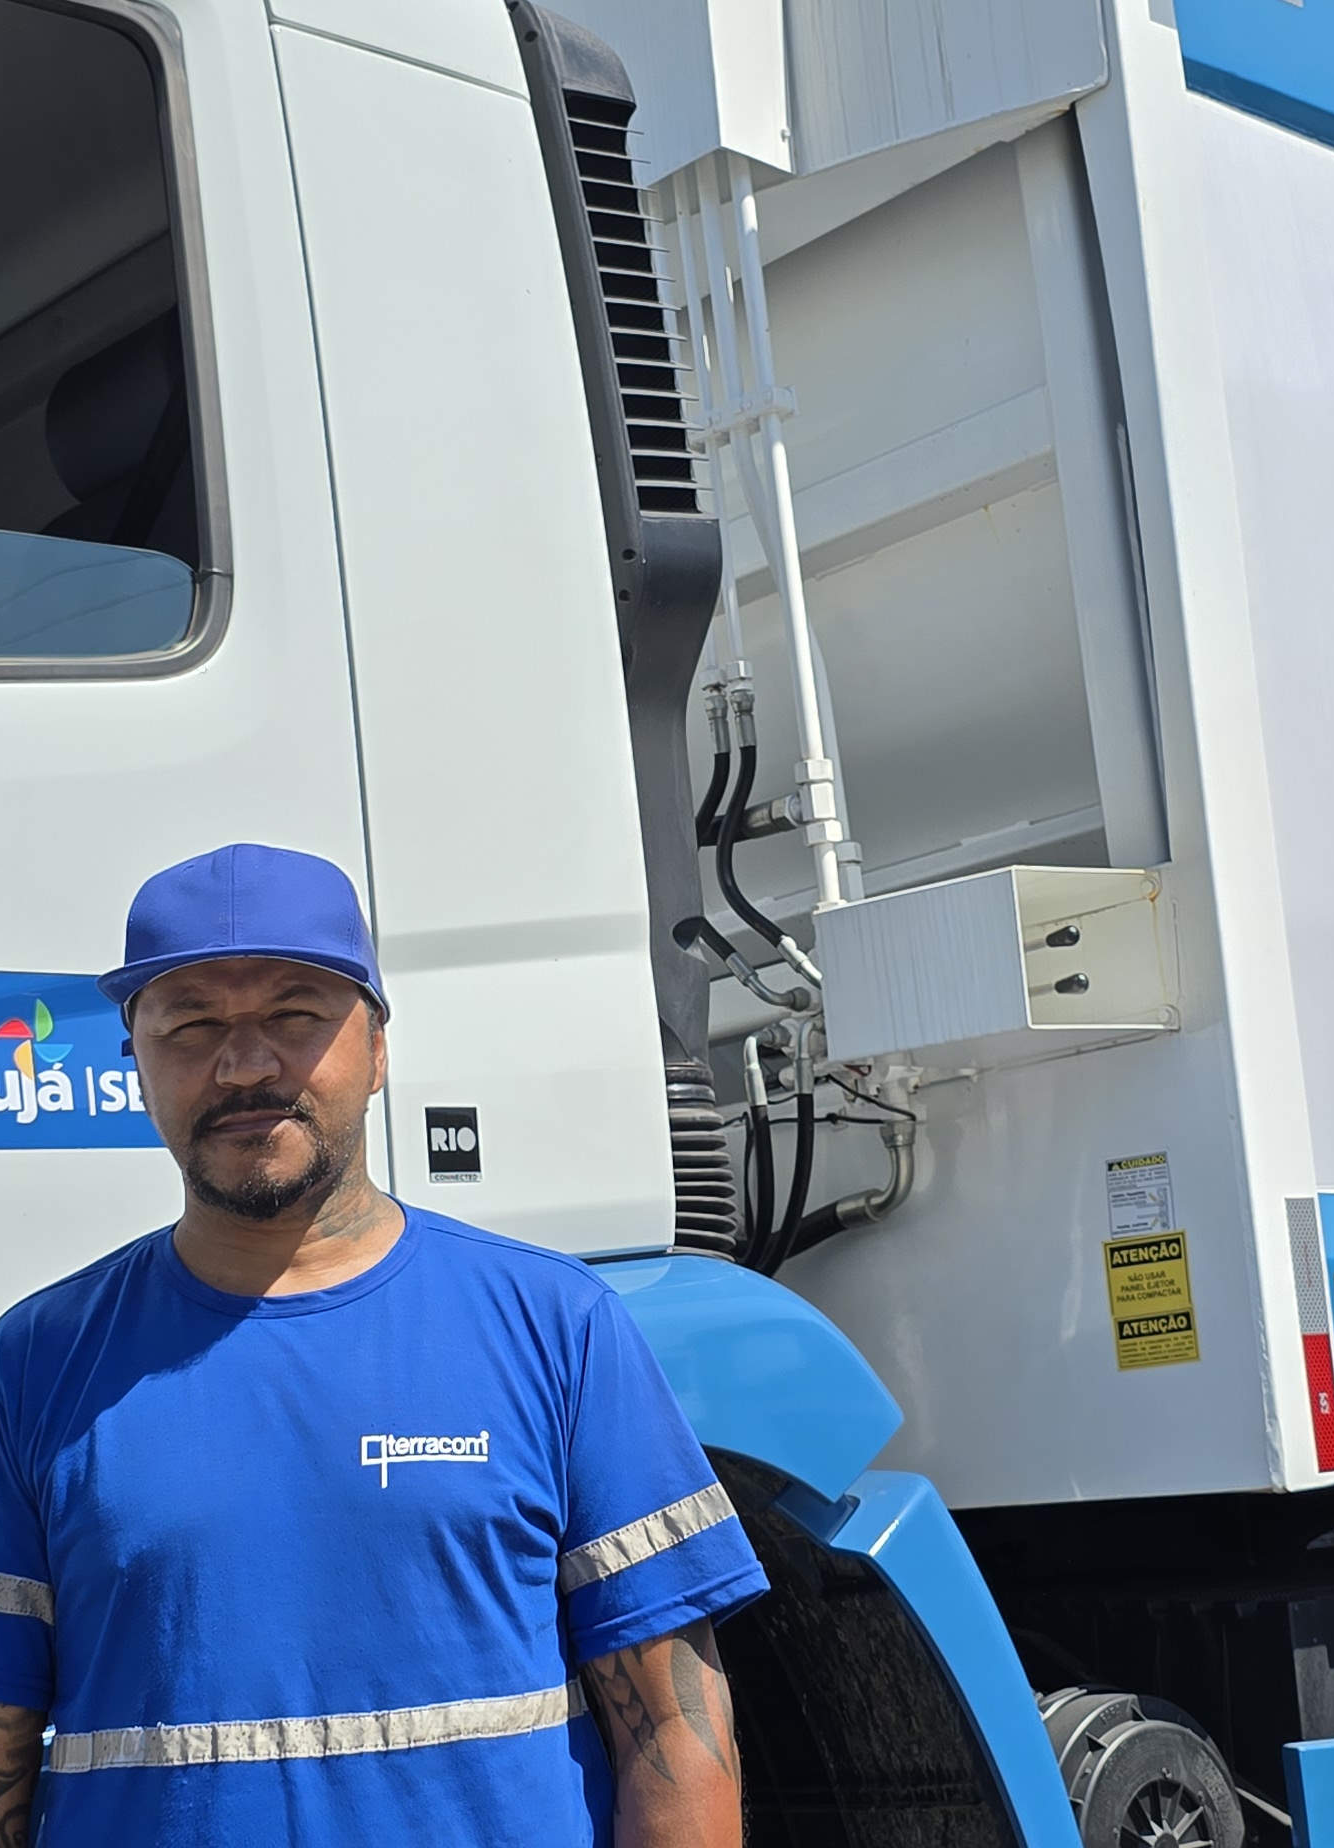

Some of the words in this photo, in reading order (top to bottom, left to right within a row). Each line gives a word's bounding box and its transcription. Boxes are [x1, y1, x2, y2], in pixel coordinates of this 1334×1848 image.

[430, 1126, 477, 1152] RIO
[1121, 1154, 1165, 1170] CUIDADO
[1112, 1242, 1180, 1265] ATENÇÃO
[1128, 1272, 1143, 1282] NÃO
[1145, 1270, 1166, 1280] USAR
[1116, 1294, 1136, 1303] PARA
[1137, 1287, 1182, 1301] COMPACTAR
[1120, 1283, 1146, 1293] PAINEL
[1147, 1279, 1175, 1290] EJETOR
[1122, 1315, 1188, 1336] ATENÇÃO
[386, 1434, 488, 1456] terracom
